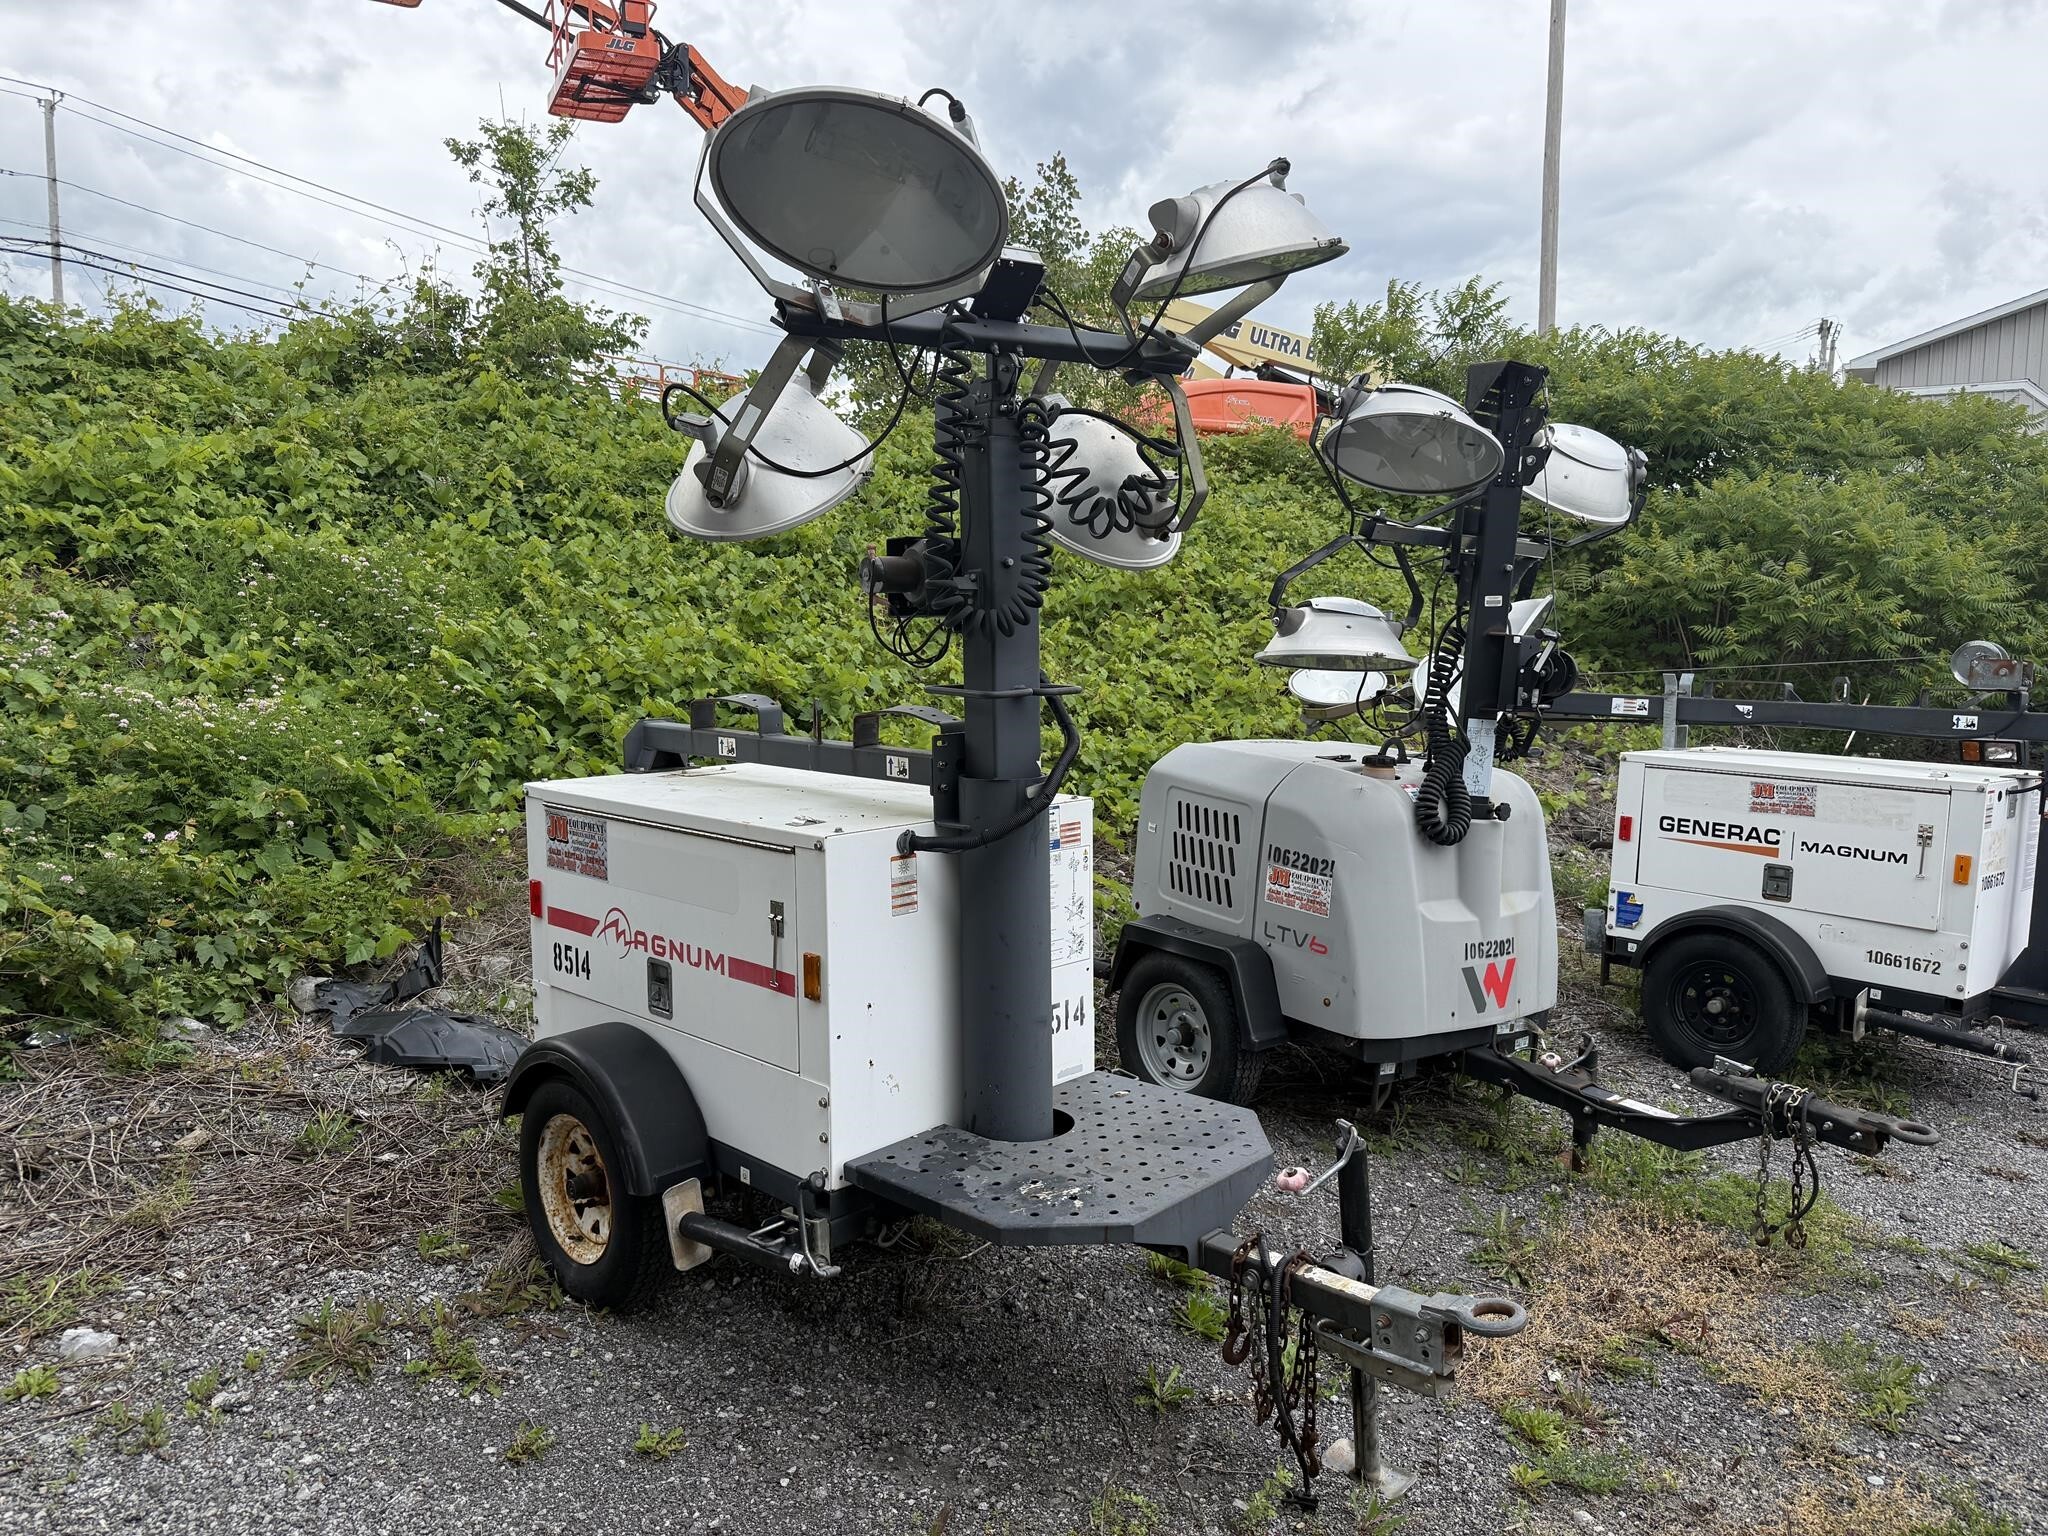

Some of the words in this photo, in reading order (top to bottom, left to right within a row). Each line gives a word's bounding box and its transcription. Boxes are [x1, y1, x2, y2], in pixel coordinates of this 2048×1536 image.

[606, 39, 635, 51] JLG
[1249, 326, 1301, 357] ULTRA
[1751, 783, 1775, 799] JM
[547, 815, 569, 844] JM
[569, 818, 605, 834] EQUIPMENT
[1659, 815, 1781, 845] GENERAC
[1801, 841, 1908, 864] MAGNUM
[1269, 867, 1291, 888] JM
[1292, 872, 1329, 887] EQUIPMENT
[597, 908, 725, 976] MAGNUM
[1465, 937, 1515, 961] 10622021
[553, 942, 592, 981] 8514
[1866, 949, 1941, 976] 10661672
[1052, 996, 1085, 1034] 514
